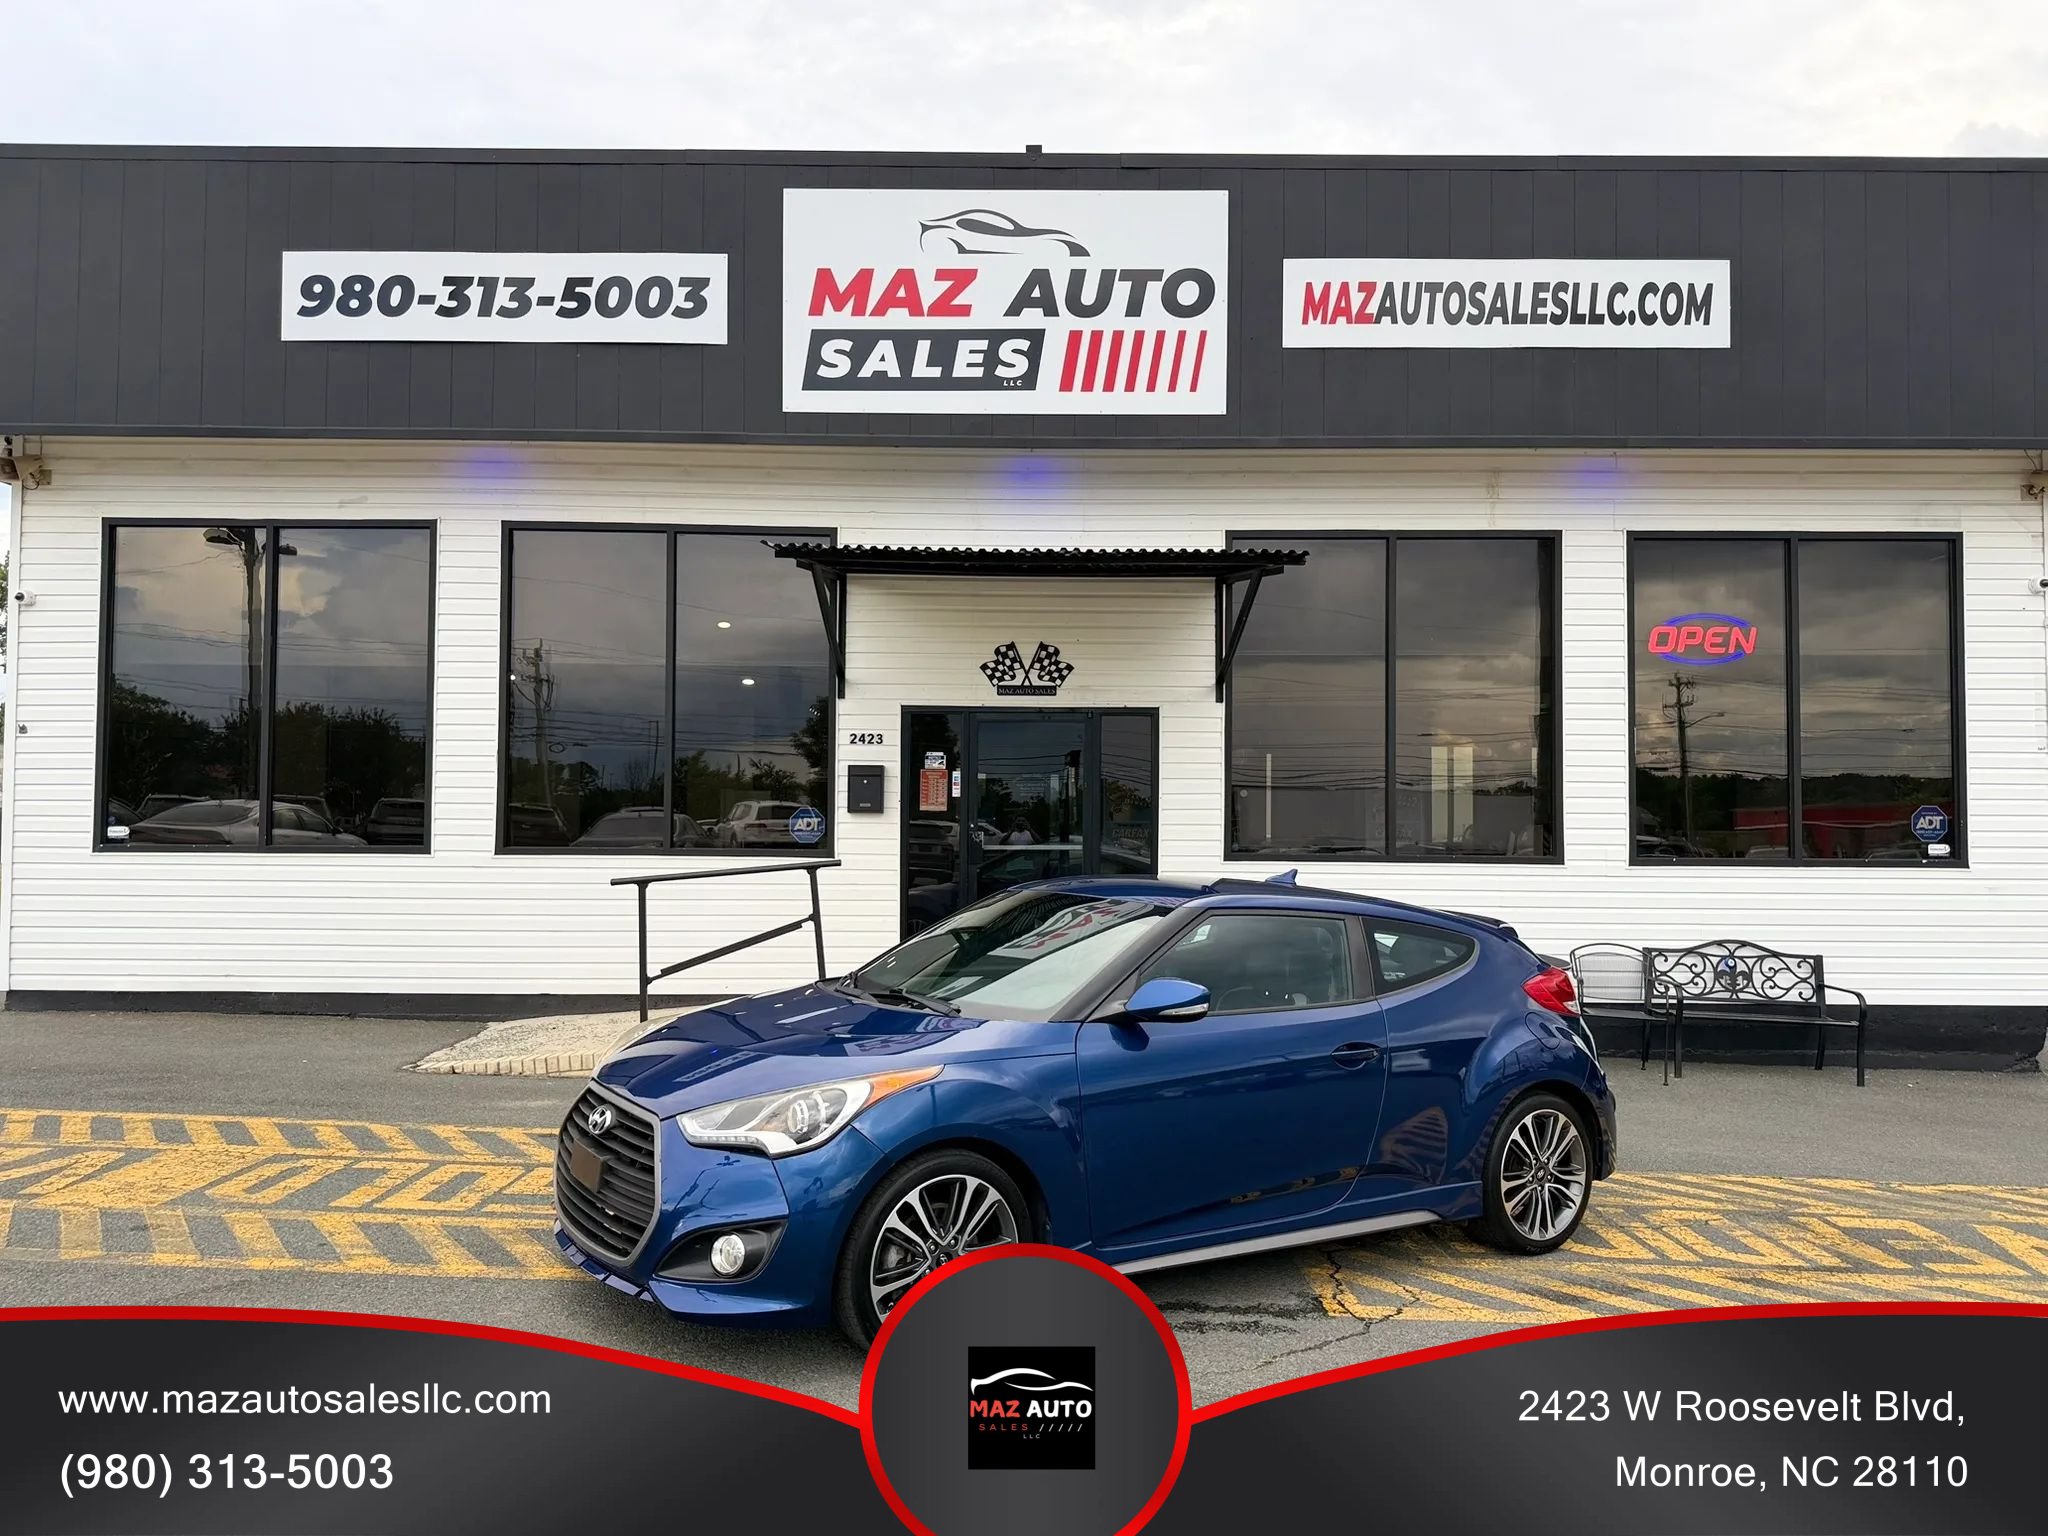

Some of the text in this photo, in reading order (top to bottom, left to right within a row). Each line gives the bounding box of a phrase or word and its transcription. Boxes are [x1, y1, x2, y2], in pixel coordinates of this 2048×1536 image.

[296, 274, 711, 320] 980-313-5003
[807, 267, 1216, 319] MAZ AUTO
[1301, 280, 1714, 327] MAZAUTOSALESLLC.COM
[816, 338, 1032, 379] SALES
[1003, 379, 1023, 387] LLC
[1647, 625, 1758, 655] OPEN
[998, 687, 1056, 695] MAZ AUTO SALES
[849, 732, 884, 745] 2423
[793, 817, 822, 831] ADT
[1915, 815, 1944, 830] ADT
